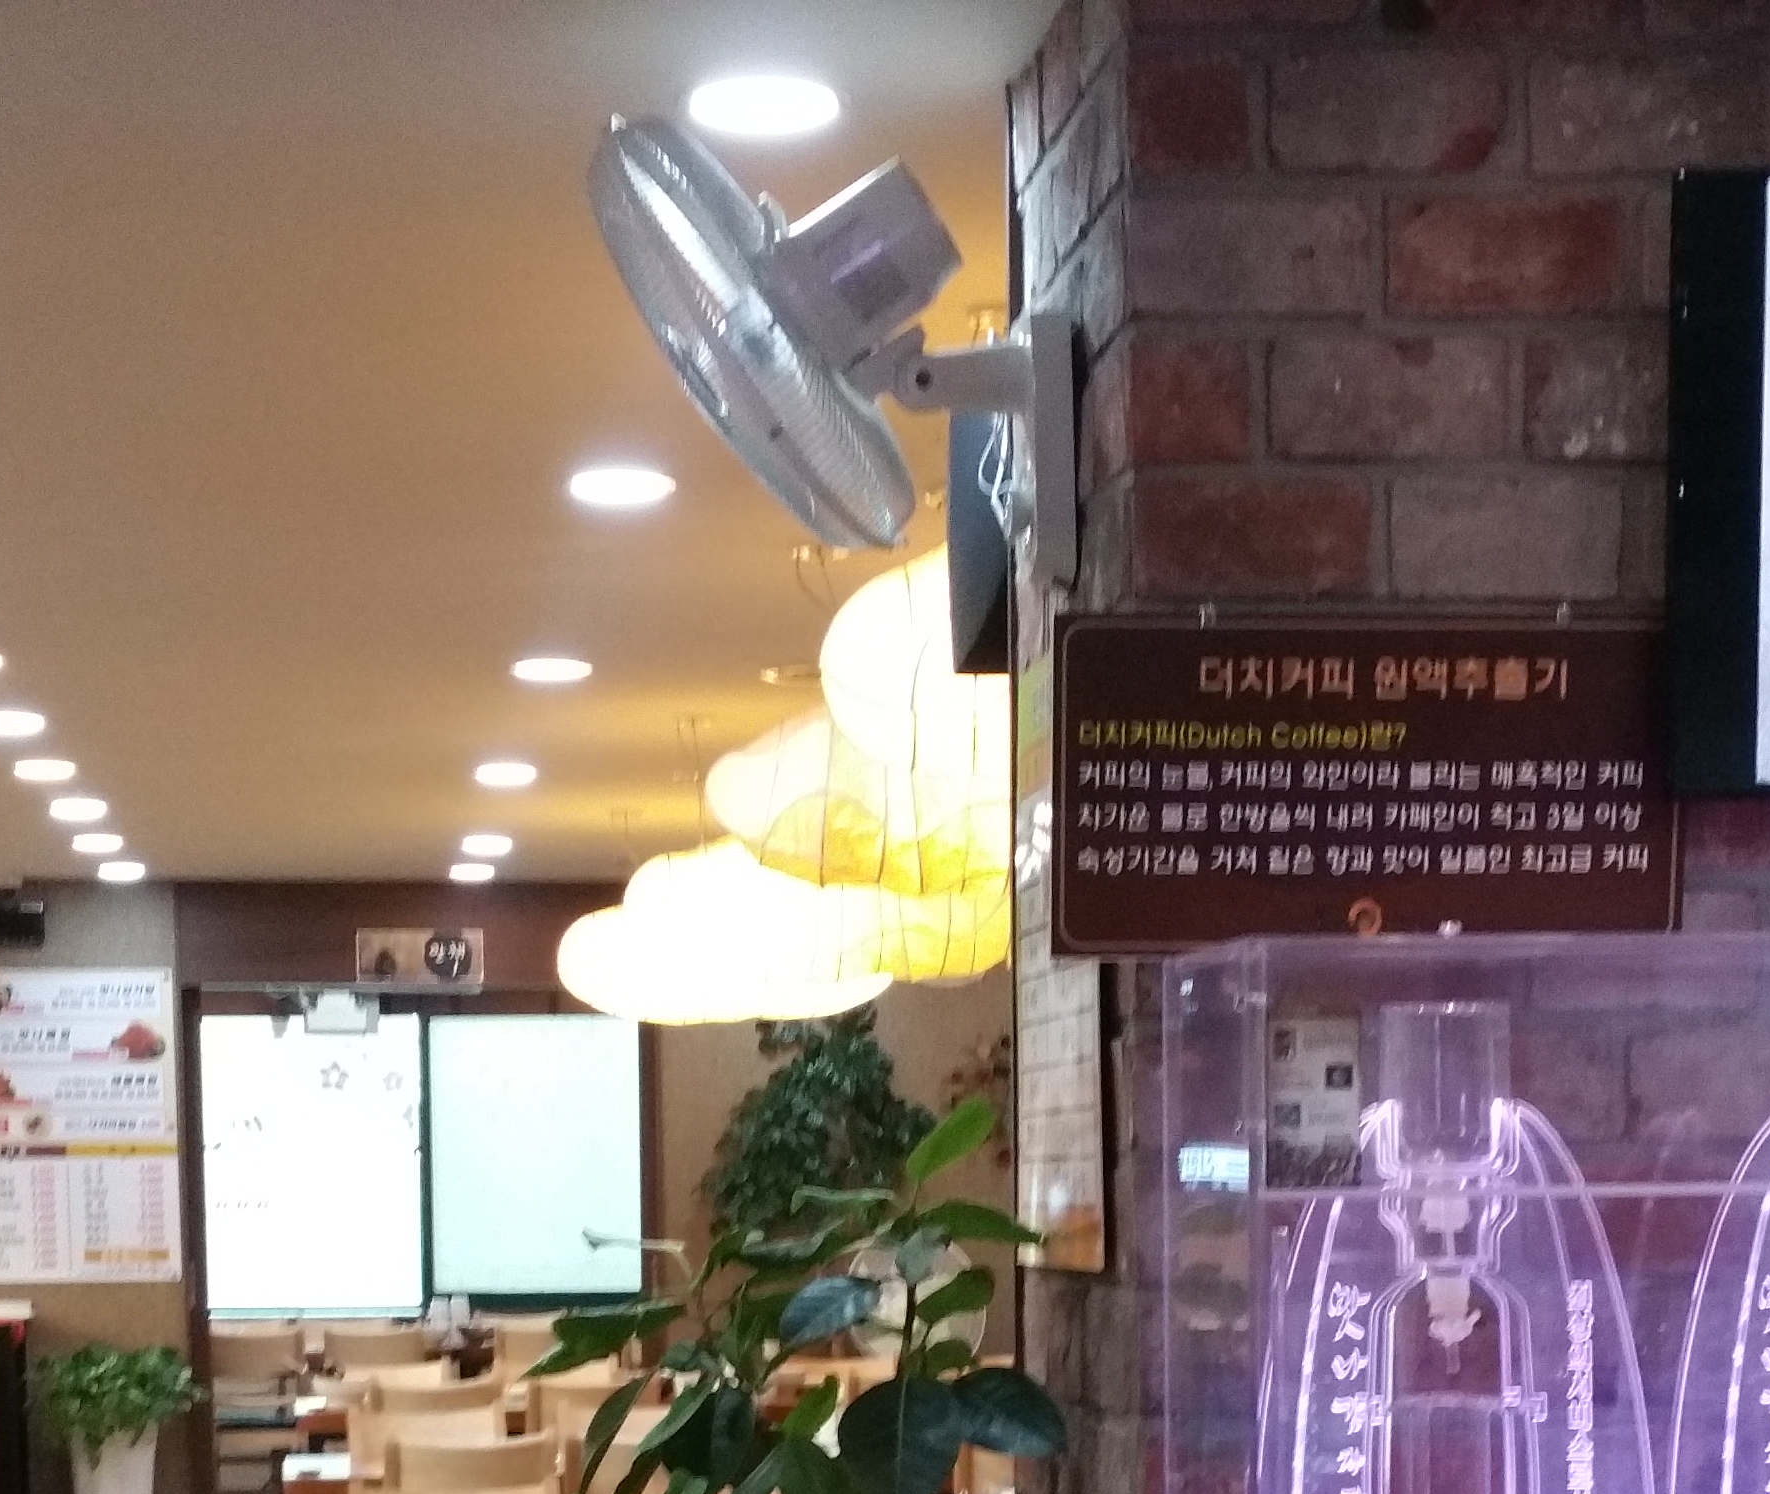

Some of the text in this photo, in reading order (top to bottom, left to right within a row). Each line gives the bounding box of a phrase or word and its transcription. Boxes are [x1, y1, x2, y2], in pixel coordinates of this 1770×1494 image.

[1198, 655, 1568, 701] 더치커피 원액추출기
[1078, 759, 1151, 791] 커피의
[1220, 759, 1293, 791] 커피의
[1301, 759, 1400, 791] 와인이라
[1408, 759, 1481, 791] 불리는
[1490, 759, 1587, 791] 매혹적인
[1596, 759, 1644, 791] 커피
[1078, 801, 1643, 833] 차가운 물로 한방울씩 내려 카페인이 적고 3일 이상
[1077, 844, 1200, 877] 숙성기간을
[1210, 844, 1258, 877] 거쳐
[1325, 844, 1373, 877] 향과
[1382, 844, 1429, 877] 맛이
[1439, 844, 1511, 877] 일품인
[1520, 844, 1592, 877] 최고급
[1601, 844, 1649, 877] 커피
